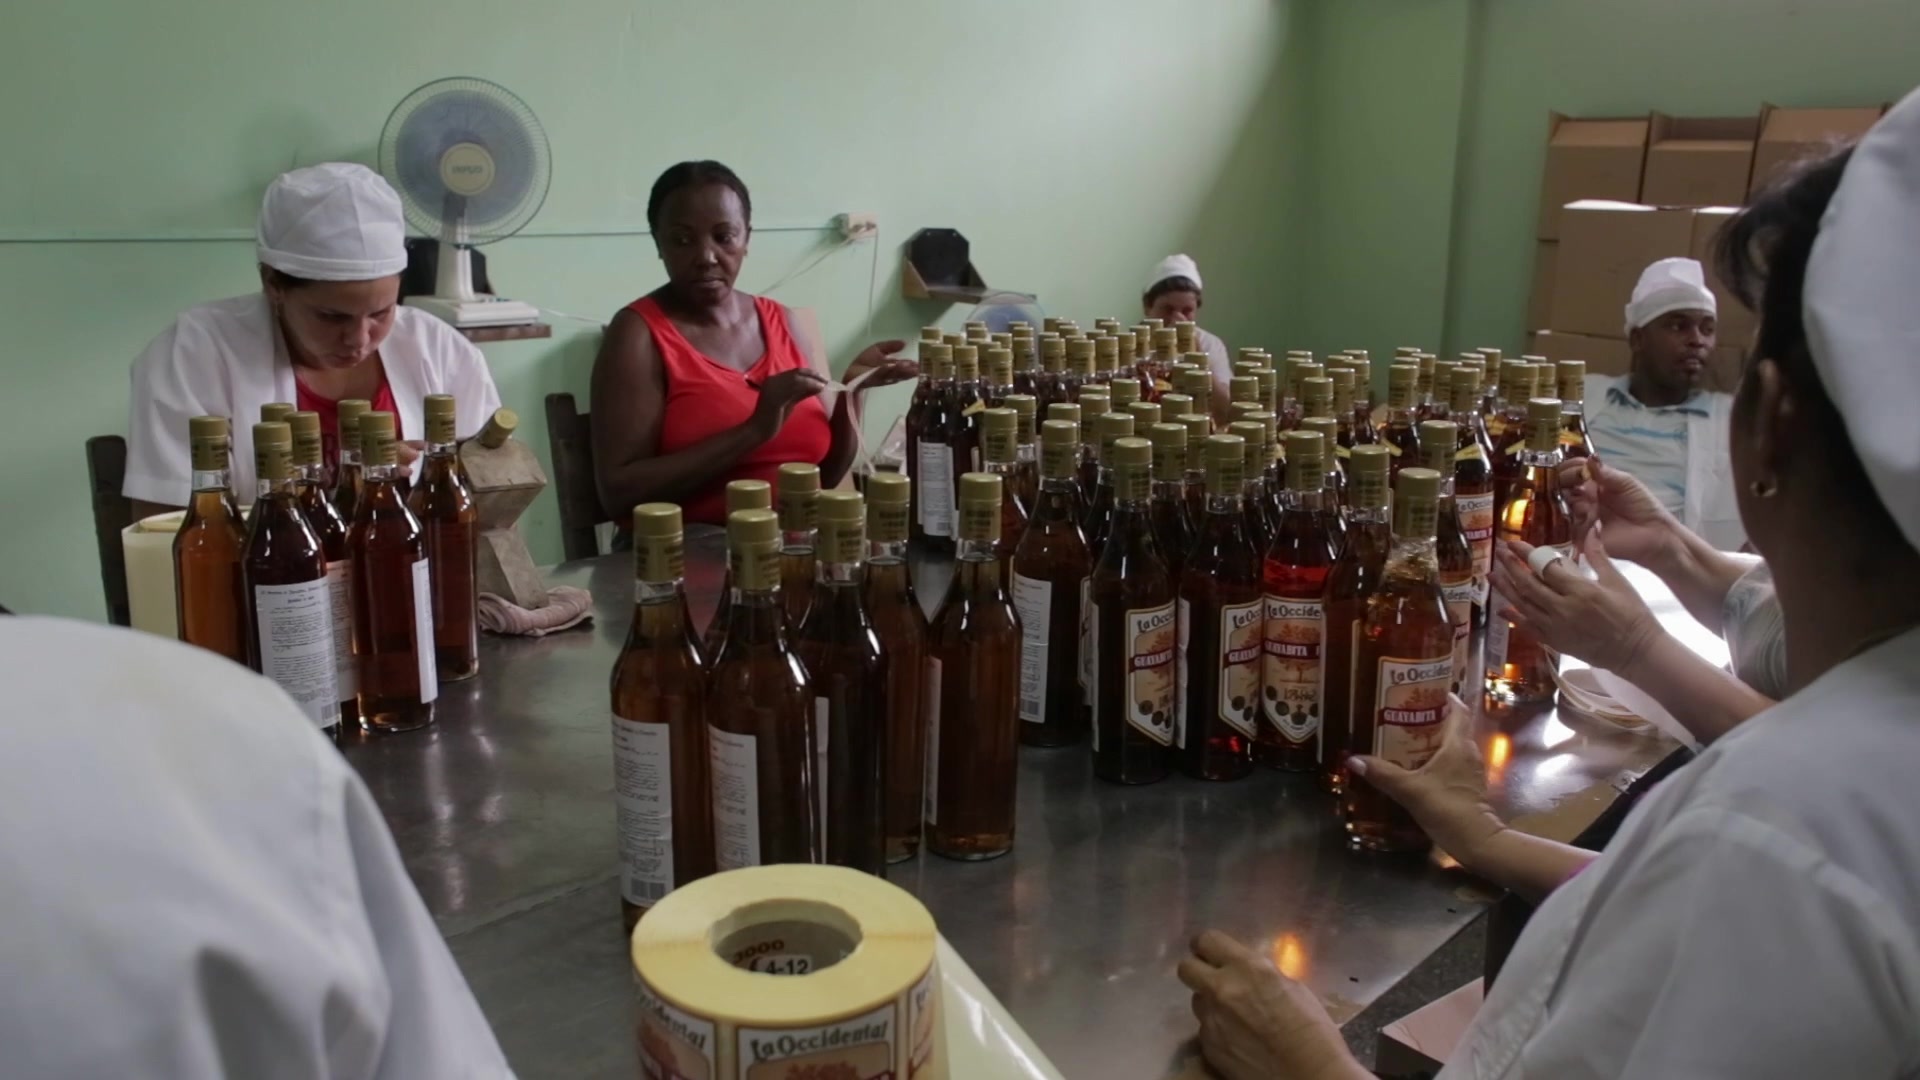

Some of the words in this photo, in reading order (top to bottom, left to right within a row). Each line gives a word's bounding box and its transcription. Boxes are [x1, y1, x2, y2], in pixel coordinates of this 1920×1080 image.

[1137, 619, 1150, 633] La
[1232, 614, 1245, 629] La
[1390, 669, 1405, 685] La
[750, 1038, 775, 1064] La
[776, 1019, 889, 1056] Occidental
